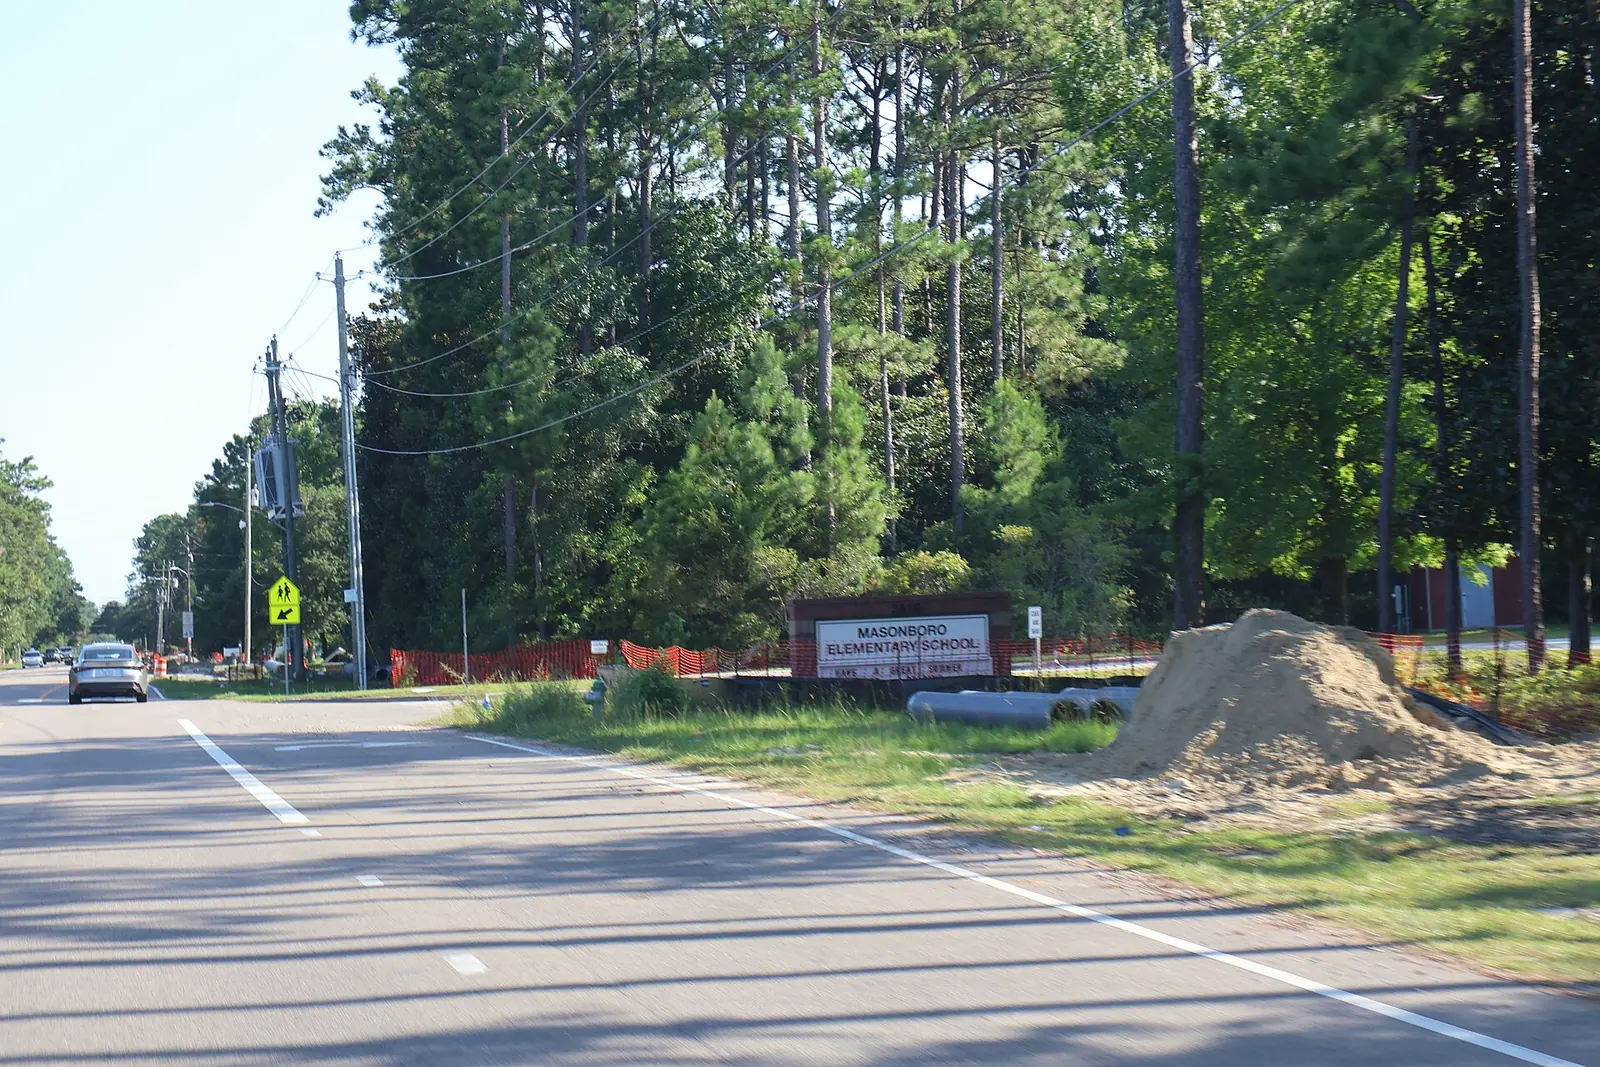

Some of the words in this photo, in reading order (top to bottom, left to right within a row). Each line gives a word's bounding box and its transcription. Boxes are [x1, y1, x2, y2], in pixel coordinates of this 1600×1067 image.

[858, 624, 947, 639] MASONBORO
[828, 640, 917, 656] ELEMENTARY
[921, 637, 979, 651] SCHOOL
